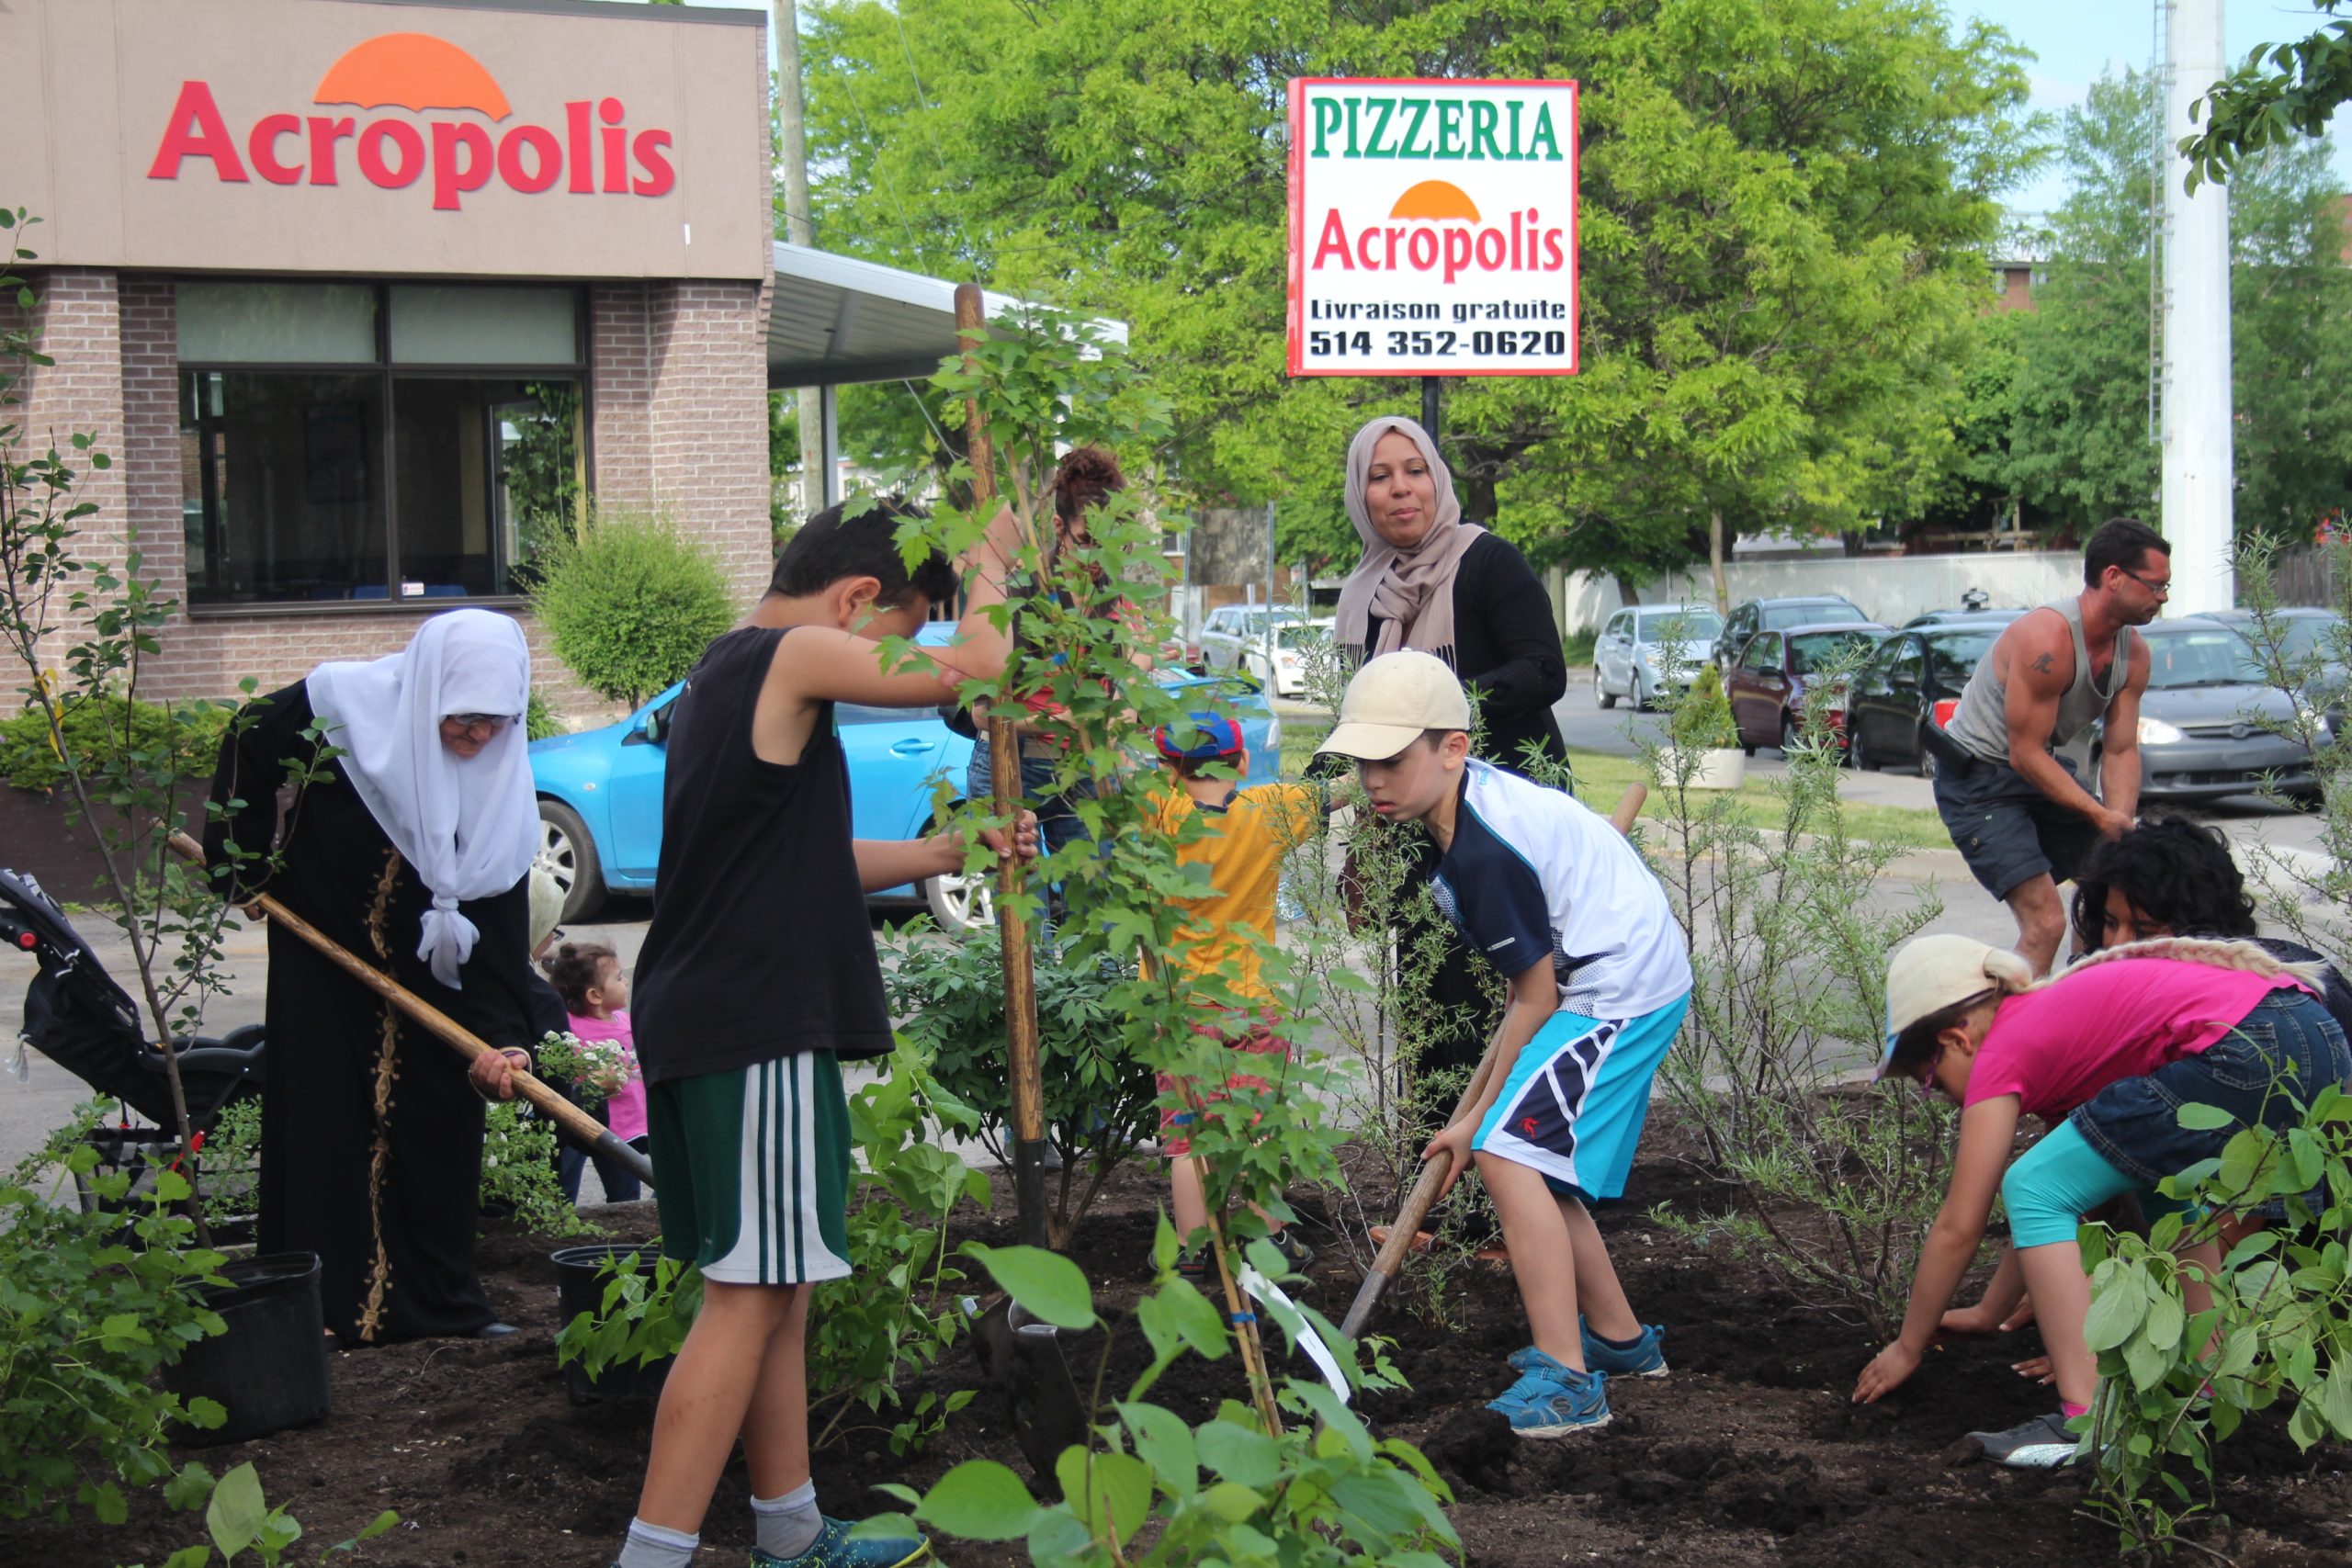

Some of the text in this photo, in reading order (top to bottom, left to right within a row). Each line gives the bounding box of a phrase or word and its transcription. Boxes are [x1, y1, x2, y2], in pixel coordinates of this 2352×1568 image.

[147, 79, 675, 210] Acropolis
[1311, 96, 1563, 161] PIZZERIA
[1311, 208, 1564, 284] Acropolis
[1311, 299, 1565, 323] Livraison gratuite
[1311, 331, 1565, 356] 514 352-0620
